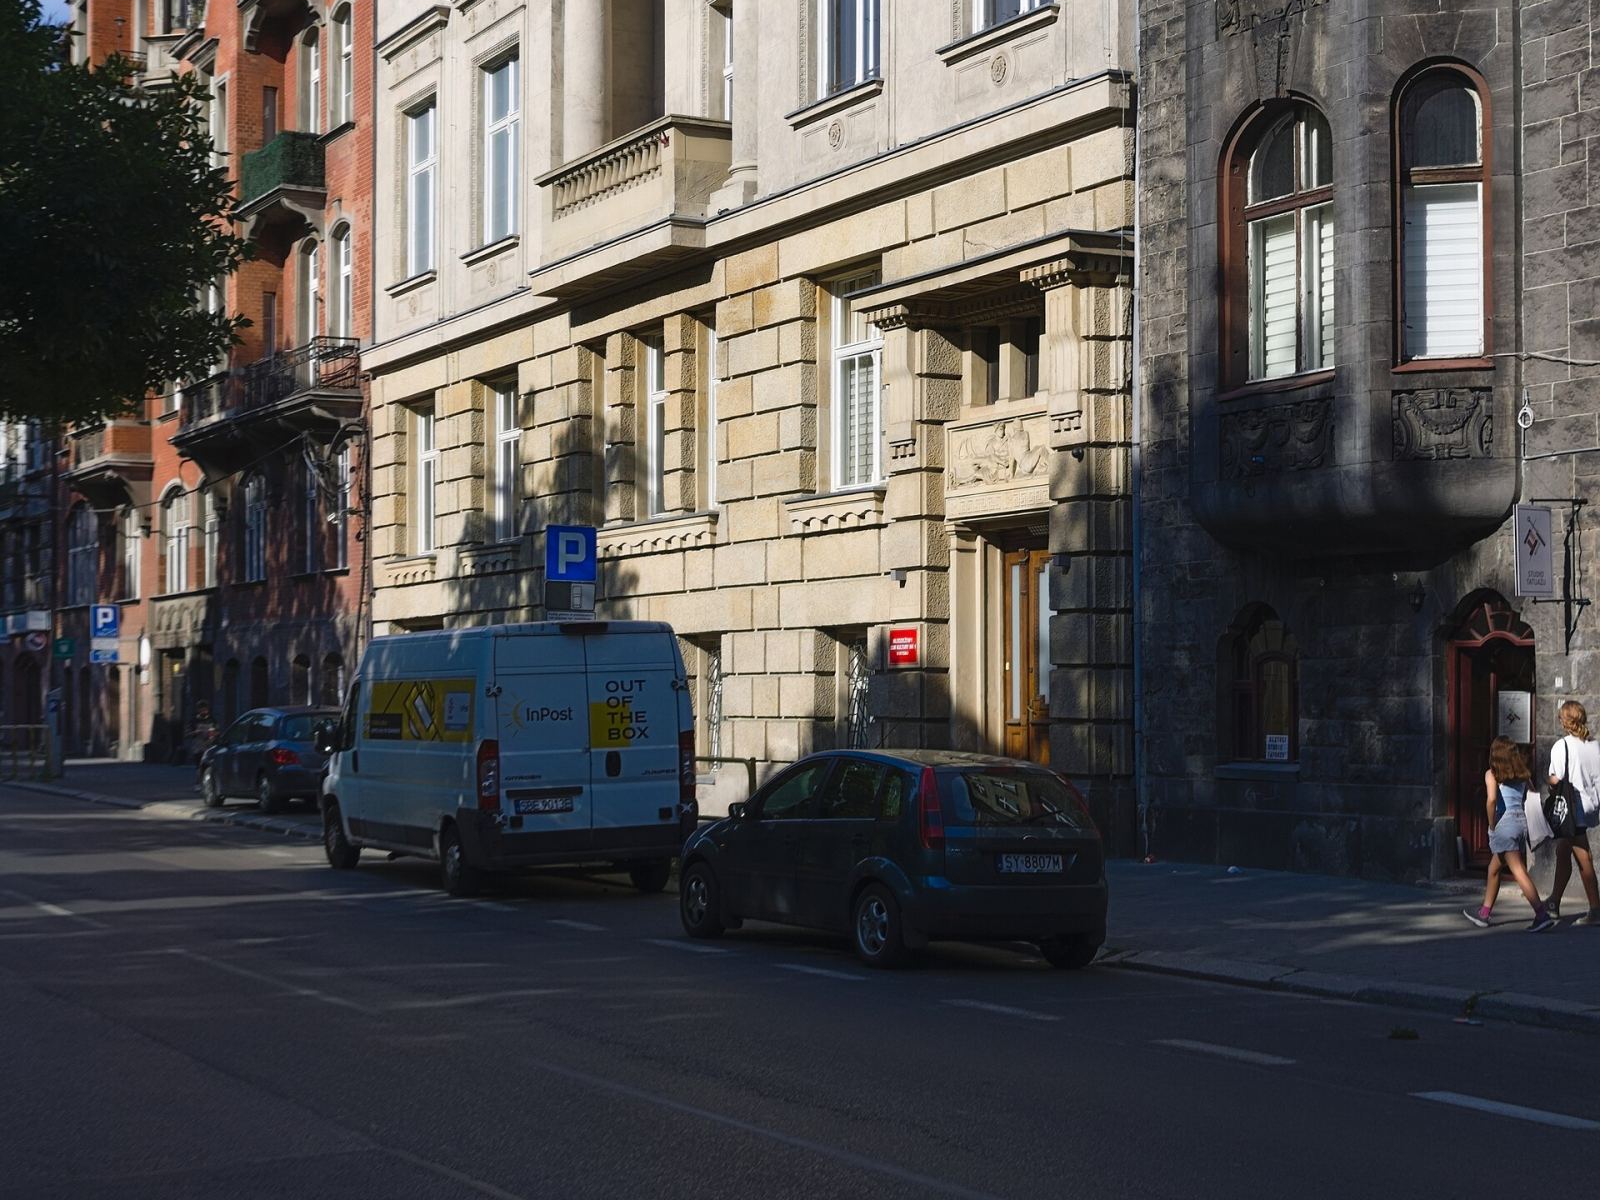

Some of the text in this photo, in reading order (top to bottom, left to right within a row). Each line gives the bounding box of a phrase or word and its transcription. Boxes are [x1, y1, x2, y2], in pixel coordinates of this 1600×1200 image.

[558, 532, 586, 574] P
[1527, 570, 1545, 578] STUDIO
[96, 607, 114, 629] P
[606, 680, 646, 692] OUT
[607, 696, 633, 708] OF
[526, 706, 574, 721] InPost
[607, 711, 648, 724] THE
[608, 727, 649, 740] BOX
[1005, 855, 1061, 869] SY 8807M
